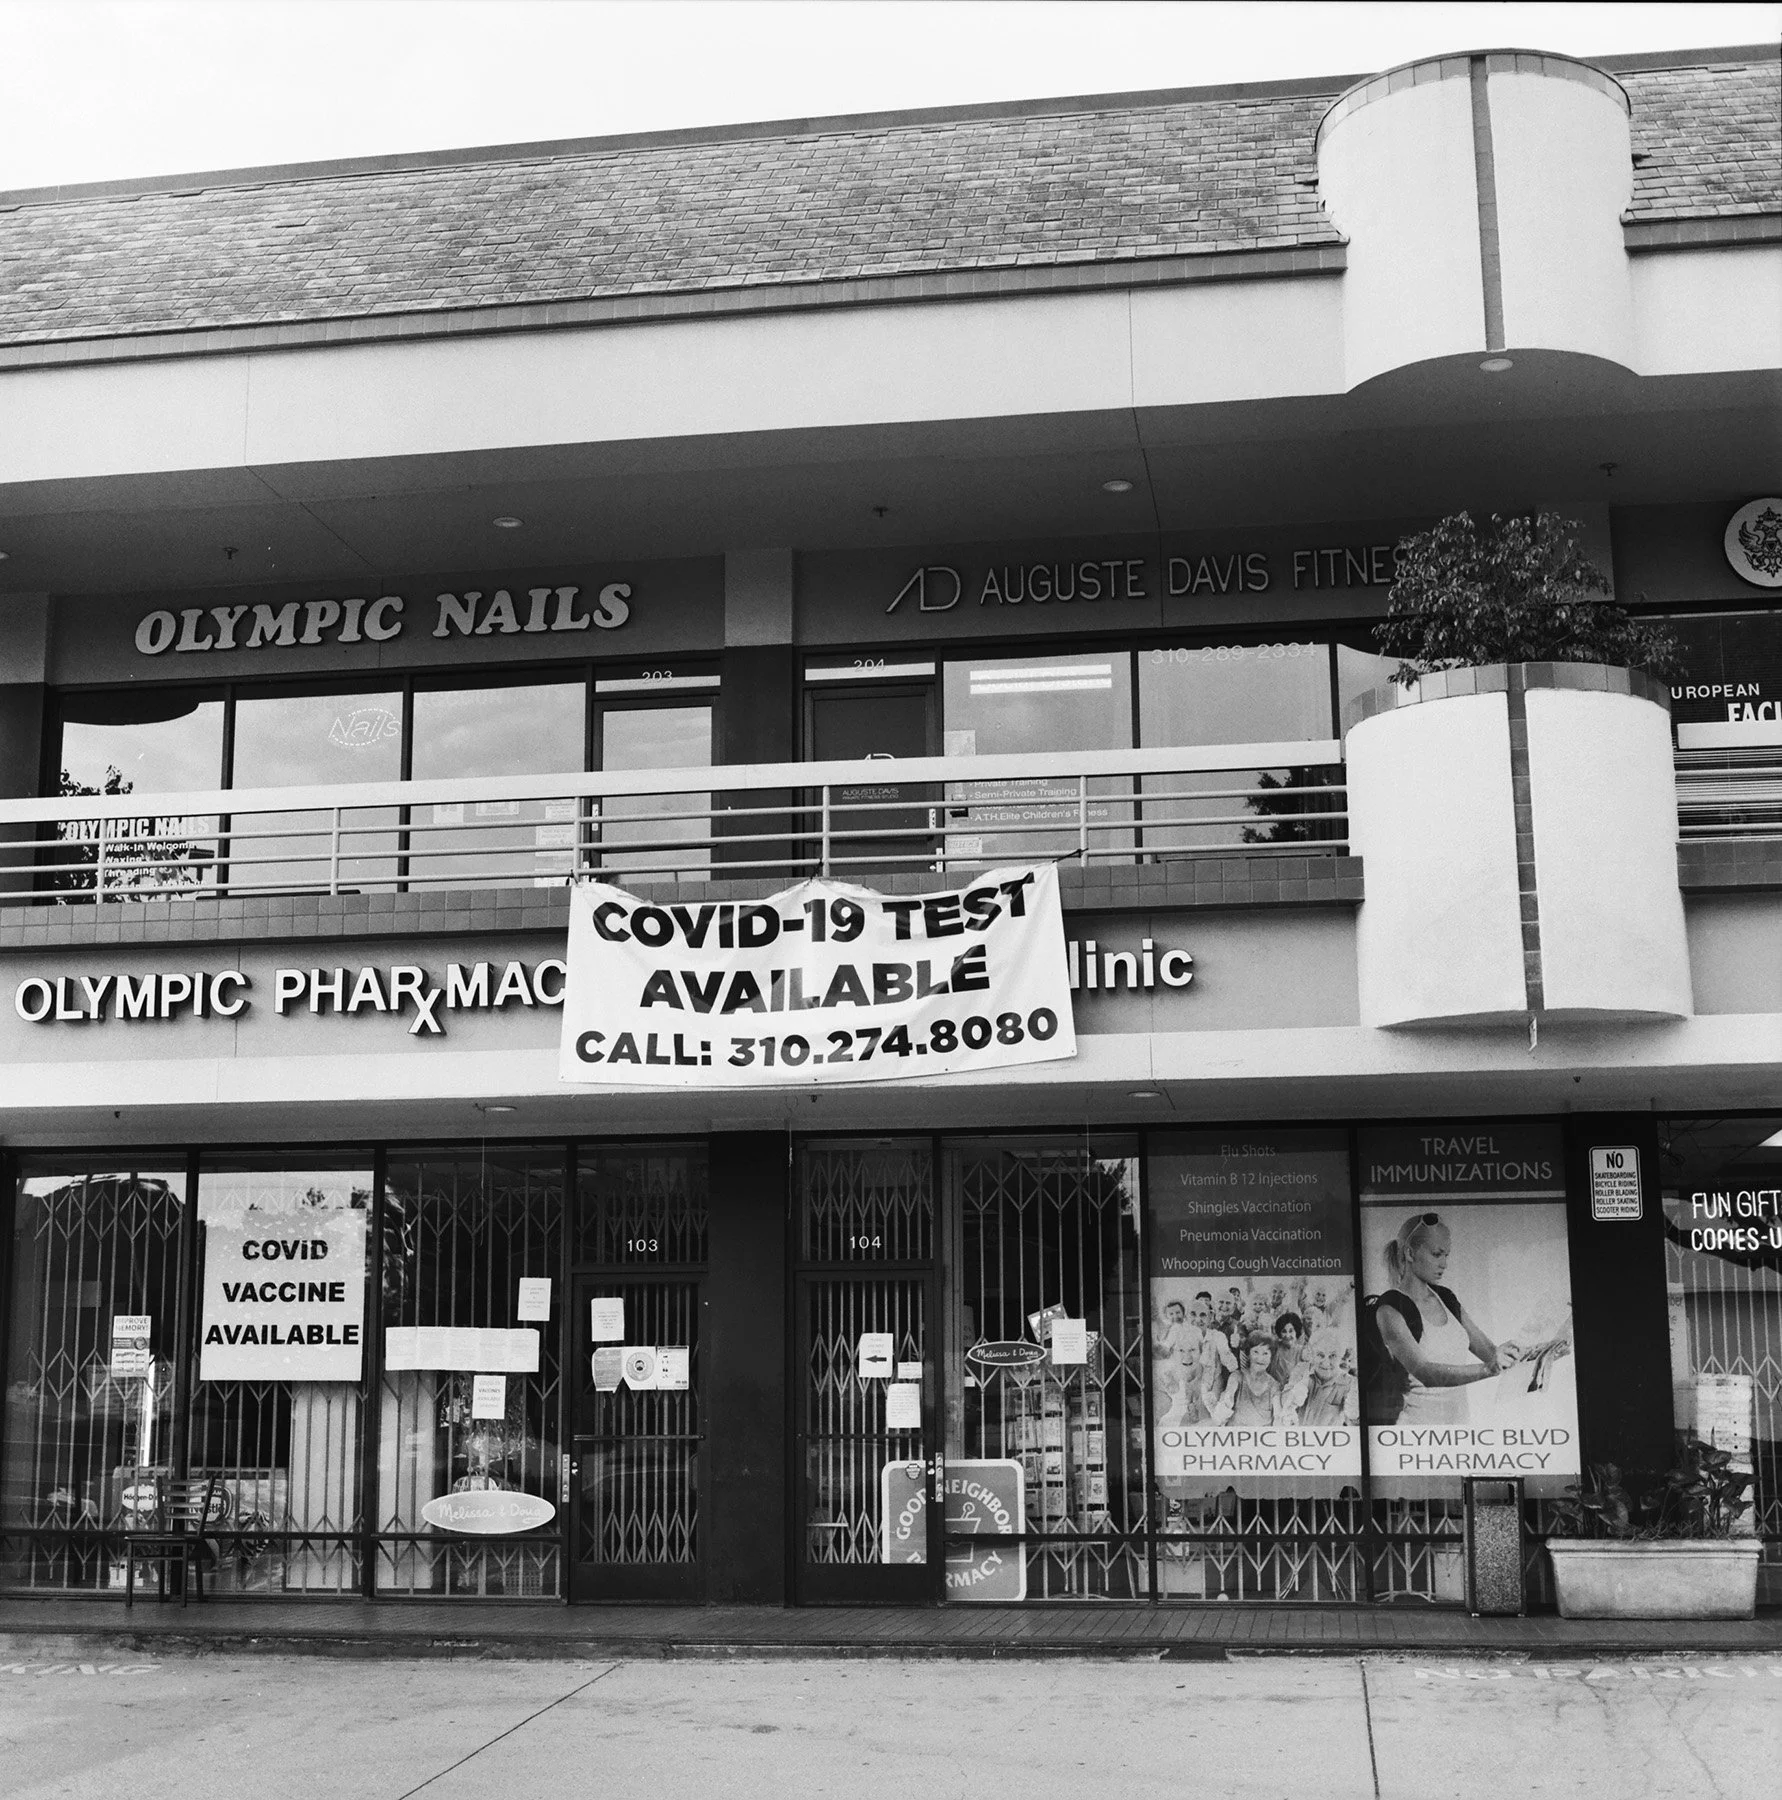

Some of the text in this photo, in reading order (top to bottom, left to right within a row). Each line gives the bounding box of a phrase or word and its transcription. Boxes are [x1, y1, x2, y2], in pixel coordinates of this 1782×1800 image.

[980, 560, 1147, 605] AUGUSTE
[1169, 553, 1269, 596] DAVIS
[1293, 545, 1413, 588] FITNE
[134, 583, 632, 655] OLYMPIC NAILS
[854, 659, 885, 672] 204
[642, 671, 673, 683] 203
[1671, 683, 1760, 700] UROPEAN
[328, 715, 401, 739] Nails
[974, 788, 1078, 800] Semi-Private Training
[1022, 808, 1071, 820] Children's
[1073, 807, 1108, 819] Fness
[593, 872, 1035, 949] COVID-19 TEST
[1068, 938, 1194, 989] linic
[639, 944, 990, 1016] AVAILABLE
[15, 970, 248, 1022] OLYMPIC
[575, 1007, 1058, 1069] CALL: 310.274.8080
[1220, 1144, 1276, 1158] Flu Shots
[1420, 1137, 1500, 1156] TRAVEL
[1606, 1153, 1624, 1169] NO
[1180, 1172, 1318, 1186] Vitamin B 12 Injections
[1371, 1162, 1553, 1183] IMMUNIZATIONS
[1594, 1172, 1637, 1180] SKATEBOARDING
[1595, 1180, 1617, 1188] BICYCLE
[1595, 1188, 1638, 1197] ROLLER BLADING
[1188, 1199, 1312, 1217] Shingles Vaccination
[1596, 1197, 1638, 1205] ROLLER SKATING
[1596, 1205, 1639, 1214] SCOOTER RIDING
[1691, 1191, 1732, 1219] FUN
[849, 1236, 882, 1250] 104
[1180, 1227, 1321, 1242] Pneumonia Vaccination
[627, 1239, 659, 1252] 103
[1161, 1255, 1342, 1274] Whooping Cough Vaccination
[222, 1281, 346, 1303] VACCINE
[205, 1324, 359, 1345] AVAILABLE
[1161, 1430, 1352, 1448] OLYMPIC BLVD
[1377, 1429, 1570, 1448] OLYMPIC BLVD
[1183, 1454, 1333, 1471] PHARMACY
[1400, 1452, 1551, 1470] PHARMACY
[437, 1503, 496, 1522] Melissa
[906, 1551, 1003, 1588] PRMACY
